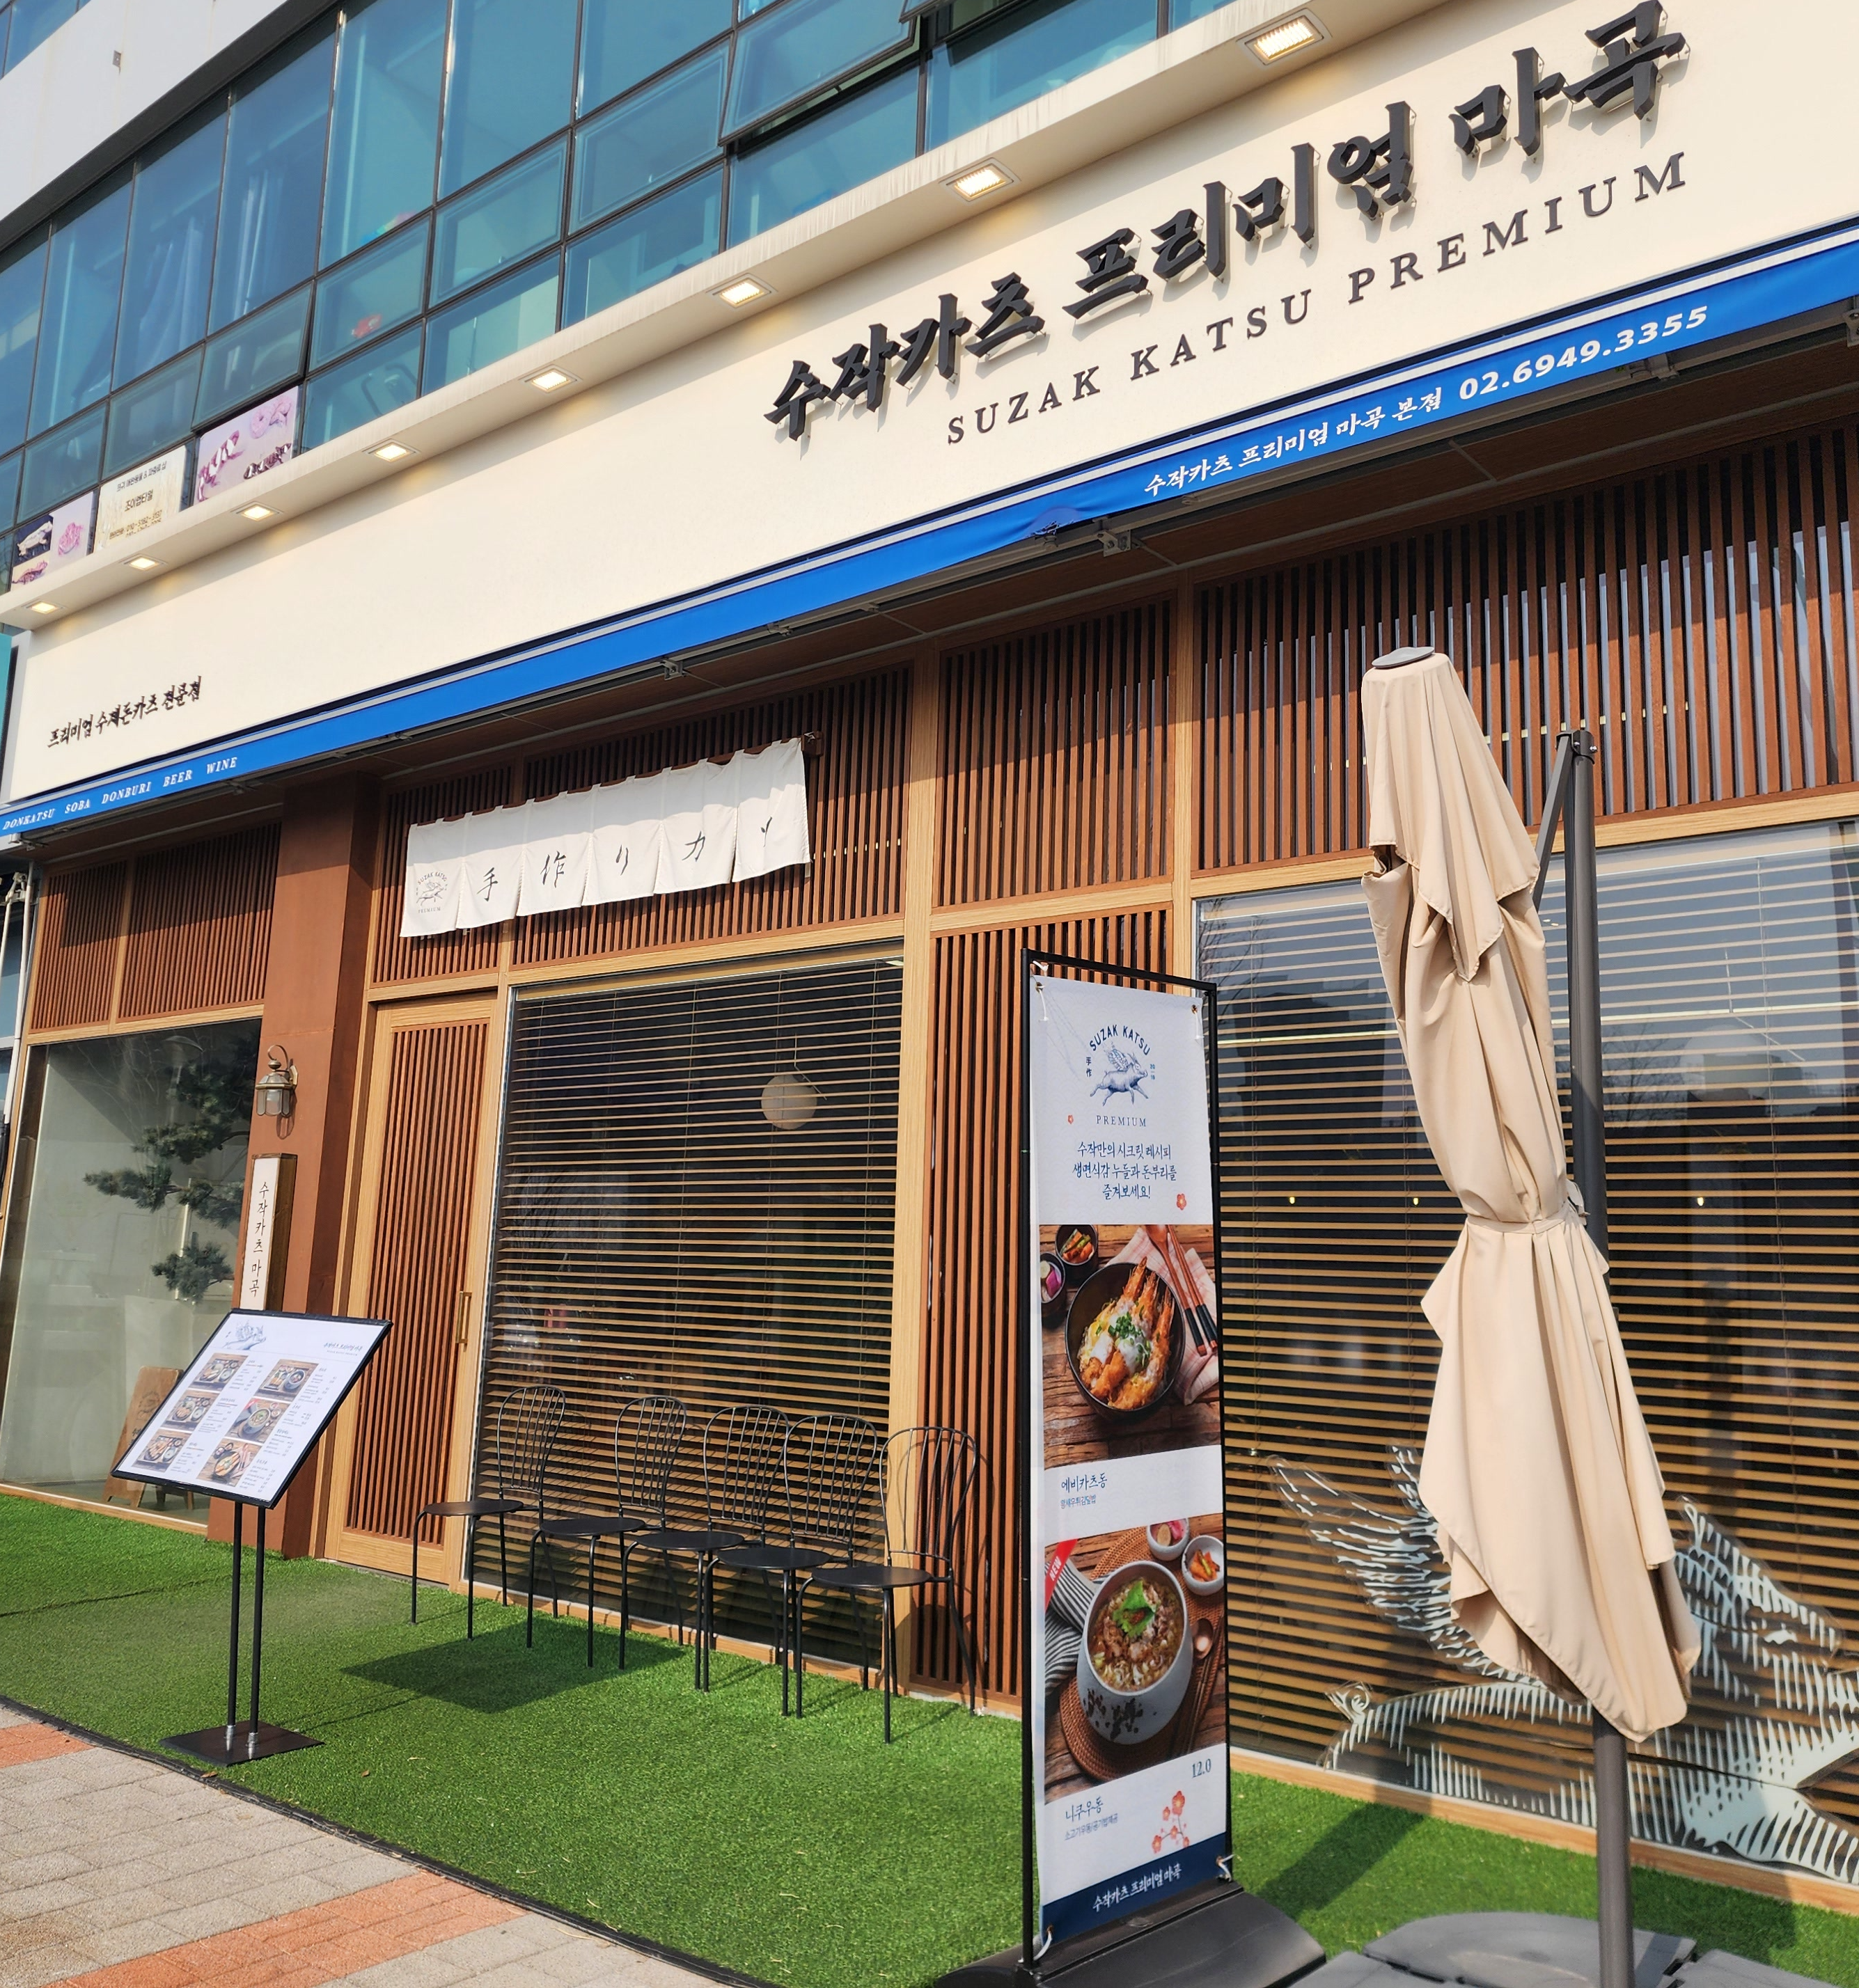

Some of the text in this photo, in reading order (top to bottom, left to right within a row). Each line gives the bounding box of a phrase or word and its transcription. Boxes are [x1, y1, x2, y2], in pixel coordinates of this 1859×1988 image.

[764, 0, 1687, 441] 수작카츠 프리미엄 마곡
[947, 152, 1686, 444] SUZAK KATSU PREMIUM
[1144, 306, 1709, 496] 수작카츠 프리미엄 마곡 본점 02.6949.3355
[47, 714, 94, 748] 프리미엄
[162, 675, 202, 710] 전문점
[2, 757, 238, 830] DONKATSU SOBA DONBURI BEER WINE
[418, 872, 434, 885] SUZAK
[1089, 1024, 1151, 1056] SUZAK KATSU
[1096, 1114, 1147, 1128] PREMIUM
[1077, 1141, 1172, 1160] 수작만의 시크릿 레시피
[1072, 1161, 1177, 1182] 생면식감 누들과 돈부리를
[1101, 1183, 1151, 1201] 즐겨보세요!
[249, 1181, 269, 1297] 수작카츠 마곡
[1061, 1472, 1108, 1493] 에비카츠동
[1049, 1556, 1062, 1581] NEW
[1191, 1758, 1211, 1778] 12.0
[1065, 1796, 1104, 1822] 니쿠우동
[1092, 1863, 1182, 1913] 수작카츠 프리미엄 마곡
